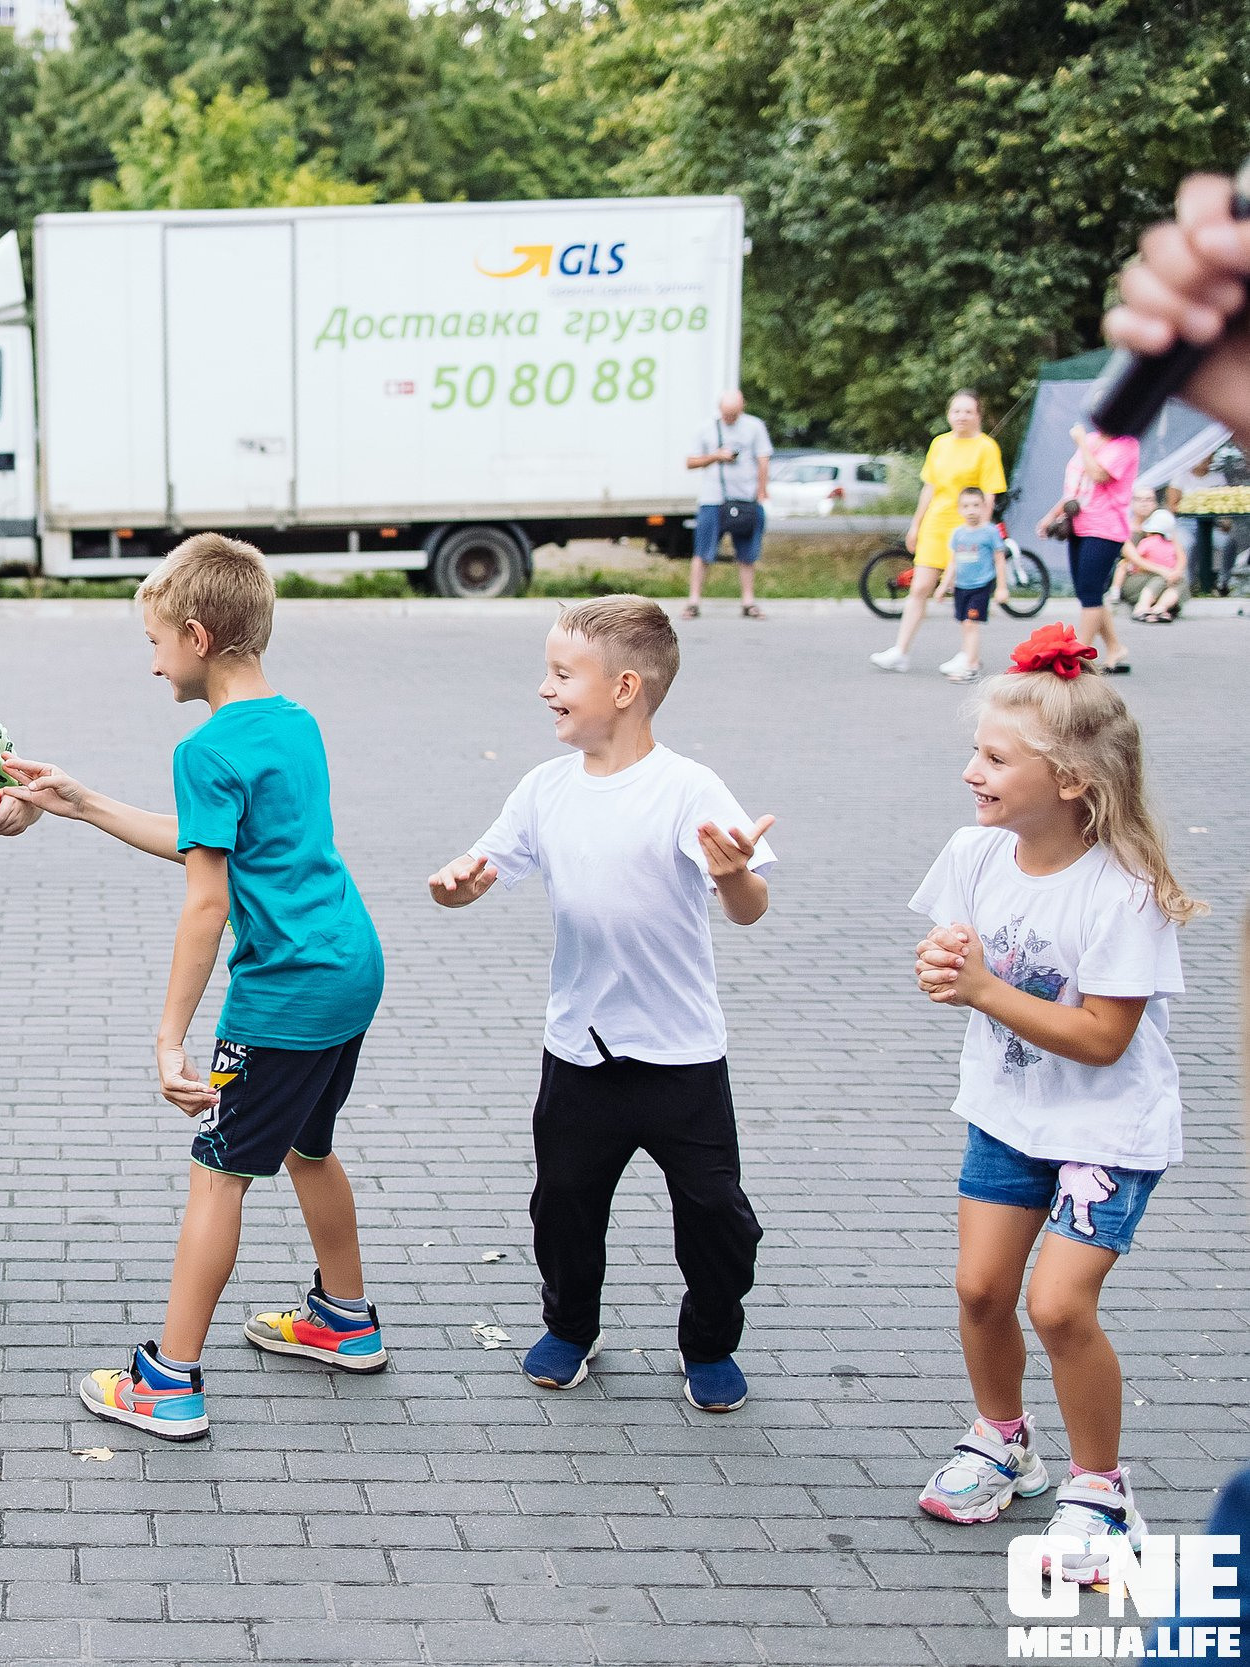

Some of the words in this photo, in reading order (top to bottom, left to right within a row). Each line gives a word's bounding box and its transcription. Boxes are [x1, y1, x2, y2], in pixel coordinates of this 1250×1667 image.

[558, 242, 626, 276] GLS
[315, 306, 539, 350] Доставка
[564, 305, 709, 343] грузов
[431, 364, 496, 410] 50
[509, 362, 576, 408] 80
[591, 358, 657, 405] 88
